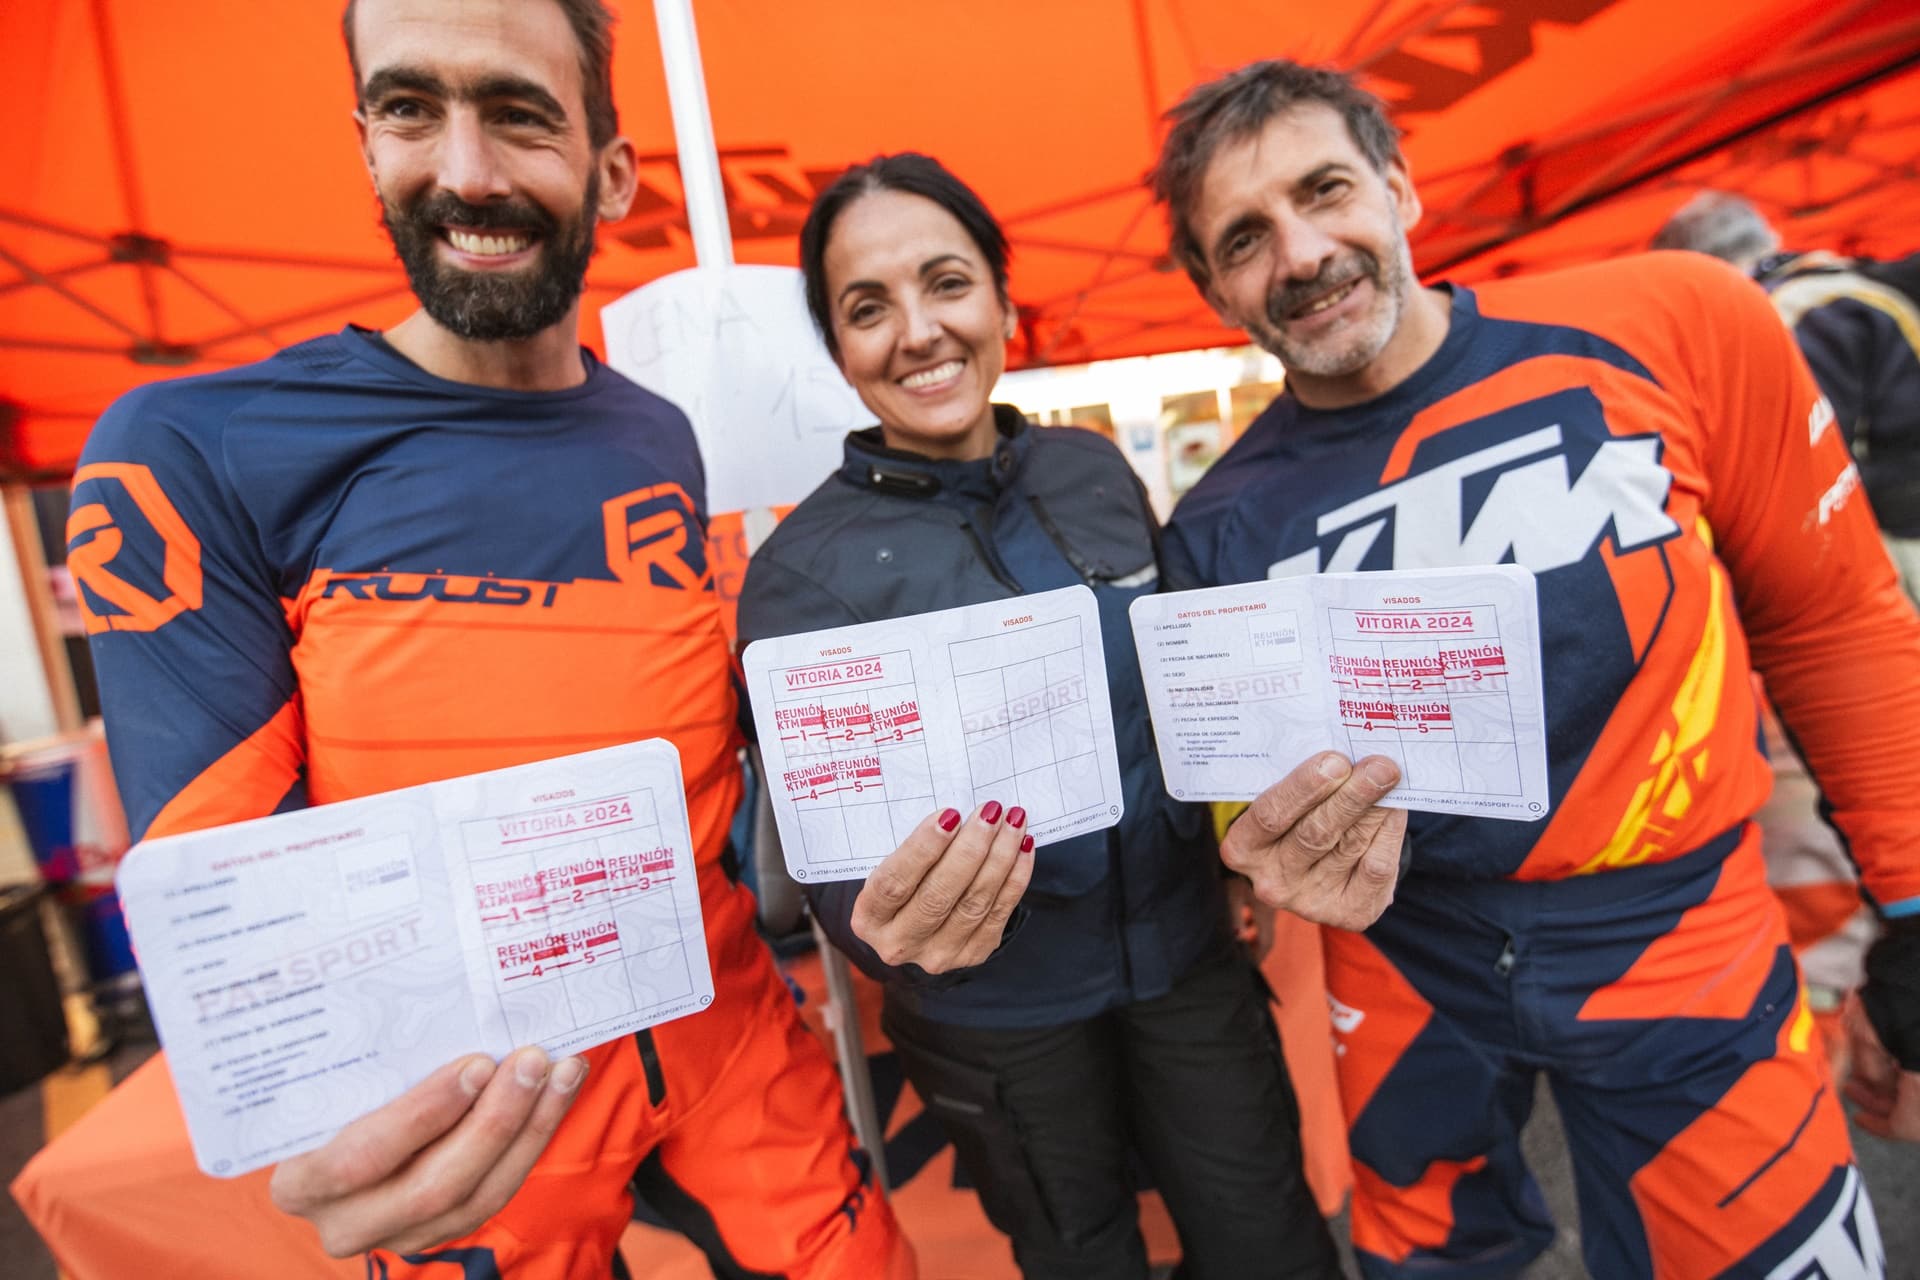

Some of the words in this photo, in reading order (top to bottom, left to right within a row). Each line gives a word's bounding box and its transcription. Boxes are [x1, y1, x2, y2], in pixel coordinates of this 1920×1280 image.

[1383, 596, 1421, 605] VISADOS
[1177, 611, 1202, 620] DATOS
[1202, 608, 1217, 617] DEL
[1218, 603, 1267, 615] PROPIETARIO
[1003, 615, 1034, 627] VISADOS
[1356, 615, 1422, 630] VITORIA
[1427, 615, 1474, 629] 2024
[820, 646, 852, 657] VISADOS
[1439, 644, 1504, 661] REUNIÓN
[1382, 656, 1442, 669] REUNIÓN
[1441, 660, 1471, 670] KTM
[785, 668, 842, 687] VITORIA
[846, 661, 883, 679] 2024
[1330, 665, 1353, 676] KTM
[1385, 668, 1412, 678] KTM
[1472, 669, 1483, 681] 3
[1353, 678, 1360, 689] 1
[1411, 679, 1423, 690] 2
[775, 703, 824, 721] REUNIÓN
[821, 703, 870, 720] REUNIÓN
[869, 701, 918, 722] REUNIÓN
[1339, 699, 1394, 712] REUNIÓN
[1392, 702, 1450, 713] REUNIÓN
[1340, 709, 1365, 719] KTM
[1393, 713, 1420, 721] KTM
[777, 718, 800, 731] KTM
[822, 717, 846, 730] KTM
[869, 720, 893, 734] KTM
[1363, 721, 1374, 732] 4
[1418, 723, 1429, 734] 5
[800, 729, 807, 741] 1
[844, 729, 855, 741] 2
[893, 729, 904, 741] 3
[830, 755, 880, 772] REUNIÓN
[783, 763, 831, 783] REUNIÓN
[832, 769, 855, 781] KTM
[786, 779, 809, 792] KTM
[853, 781, 864, 793] 5
[808, 789, 819, 801] 4
[498, 813, 577, 837] VITORIA
[583, 802, 632, 824] 2024
[608, 847, 674, 868] REUNIÓN
[540, 857, 606, 879] REUNIÓN
[609, 868, 641, 881] KTM
[637, 877, 651, 891] 3
[479, 894, 511, 909] KTM
[572, 889, 584, 903] 2
[509, 907, 520, 921] 1
[499, 954, 532, 969] KTM
[584, 952, 595, 964] 5
[531, 964, 543, 977] 4
